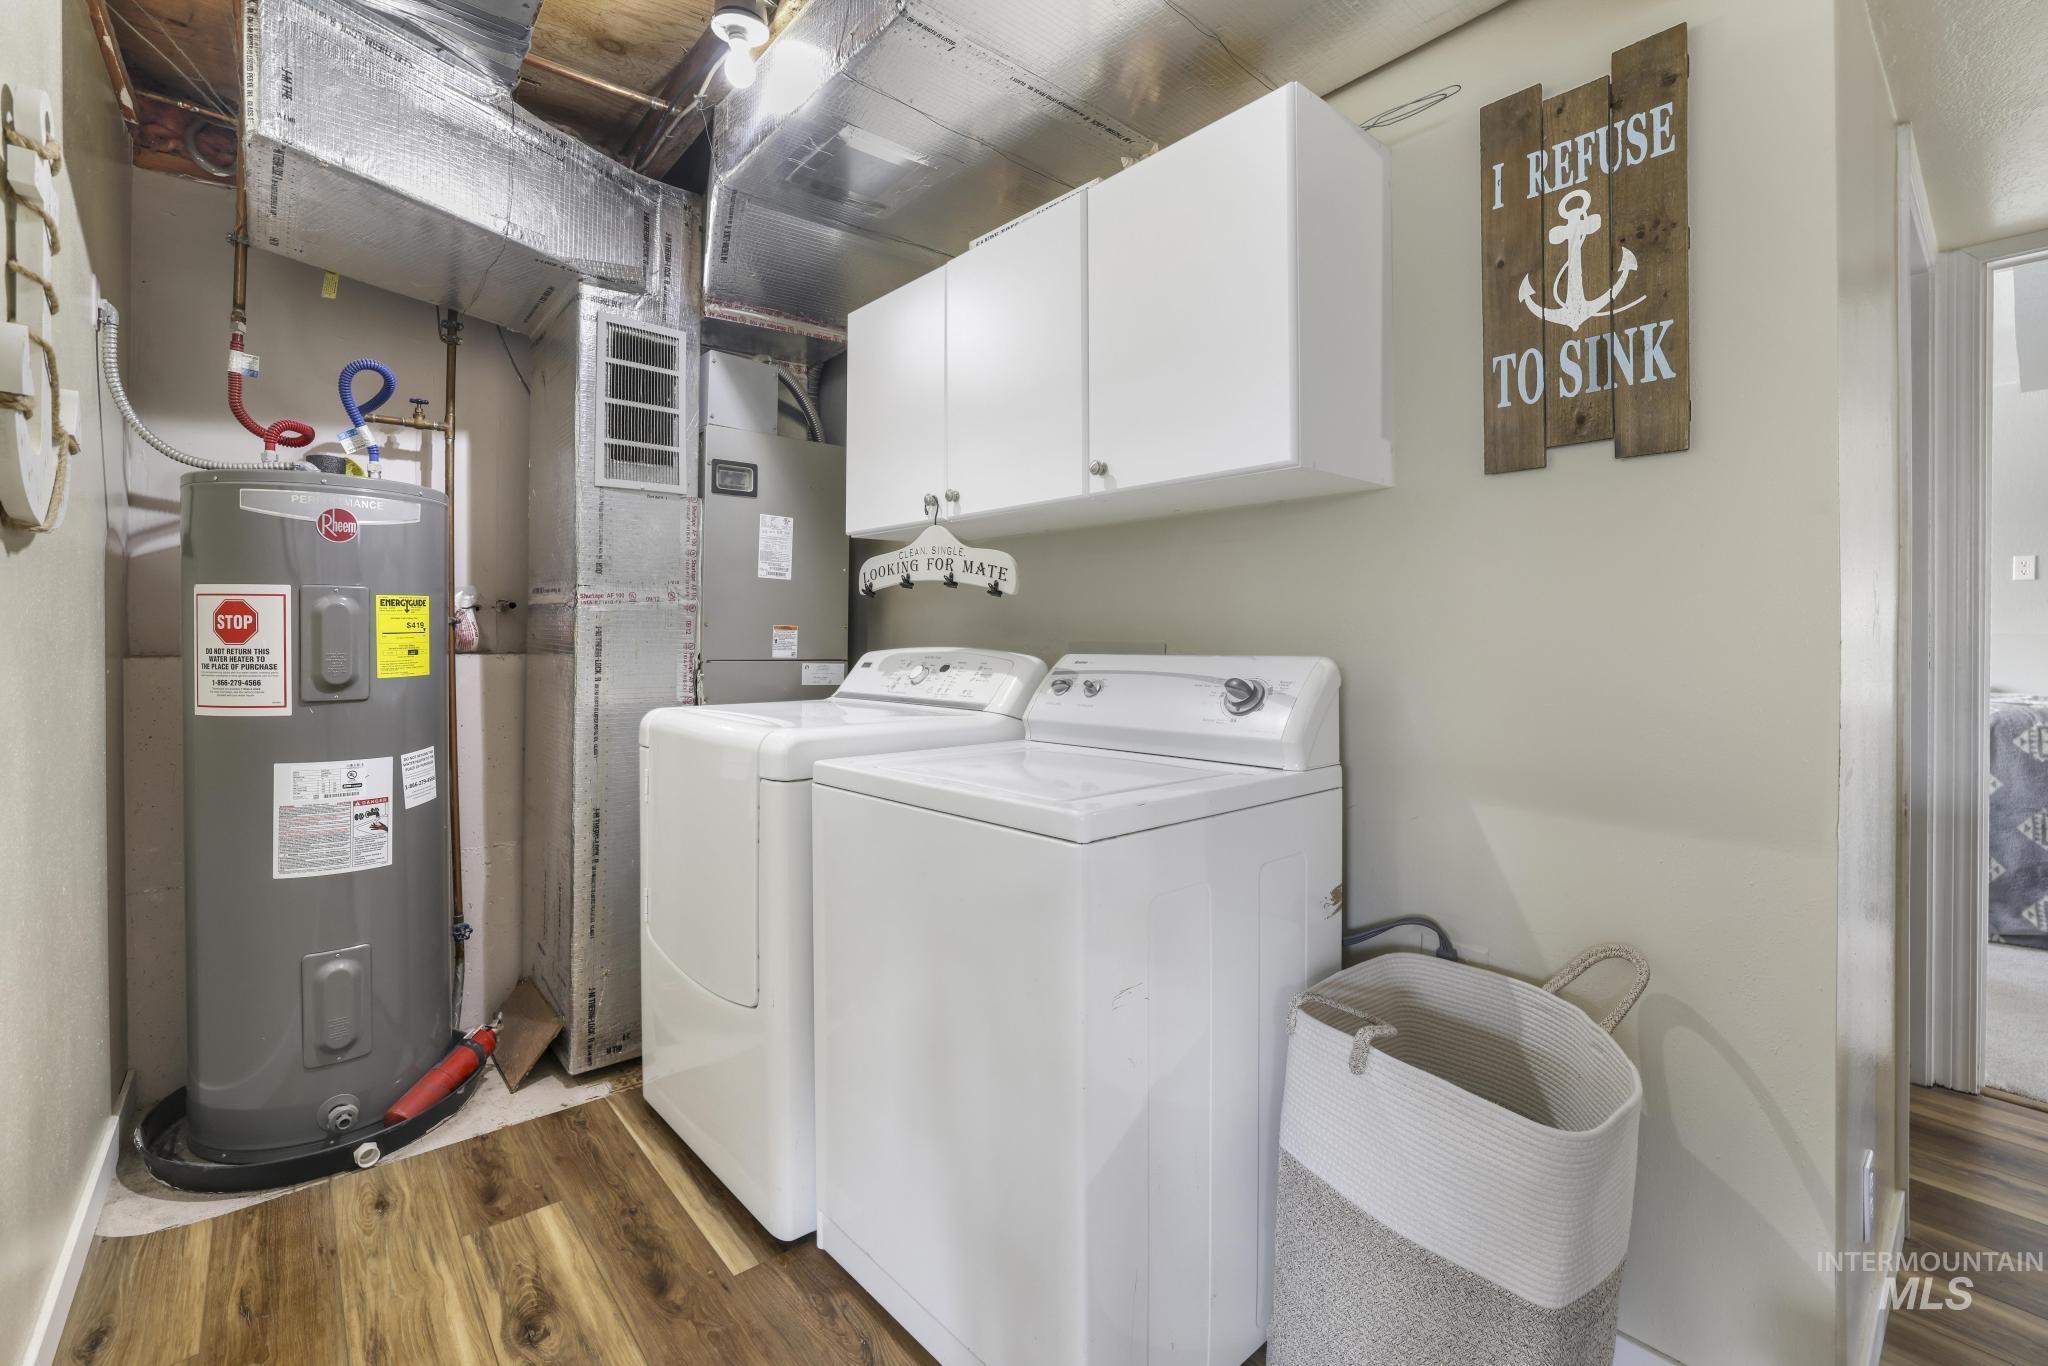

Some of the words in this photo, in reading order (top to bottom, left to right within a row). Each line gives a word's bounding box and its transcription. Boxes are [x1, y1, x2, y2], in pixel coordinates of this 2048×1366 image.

[1492, 163, 1504, 210] I
[1526, 101, 1676, 200] REFUSE
[1492, 347, 1544, 409] TO
[1559, 319, 1677, 399] SINK
[291, 494, 384, 511] PERMANCE
[321, 508, 357, 537] Rheem
[898, 547, 927, 560] CLEAN.
[931, 546, 966, 557] SINGLE.
[863, 559, 919, 584] LOOKING
[926, 557, 953, 572] FOR
[962, 560, 1009, 582] MATE
[216, 614, 253, 630] STOP
[595, 625, 603, 636] J-M
[205, 647, 213, 655] DO
[208, 655, 228, 663] WATER
[229, 655, 254, 663] HEATER
[594, 637, 603, 675] THERM-LOCK
[241, 663, 278, 671] PURCHASE
[212, 679, 262, 687] 1-866-279-4566
[592, 818, 600, 856] THERM-LOCK
